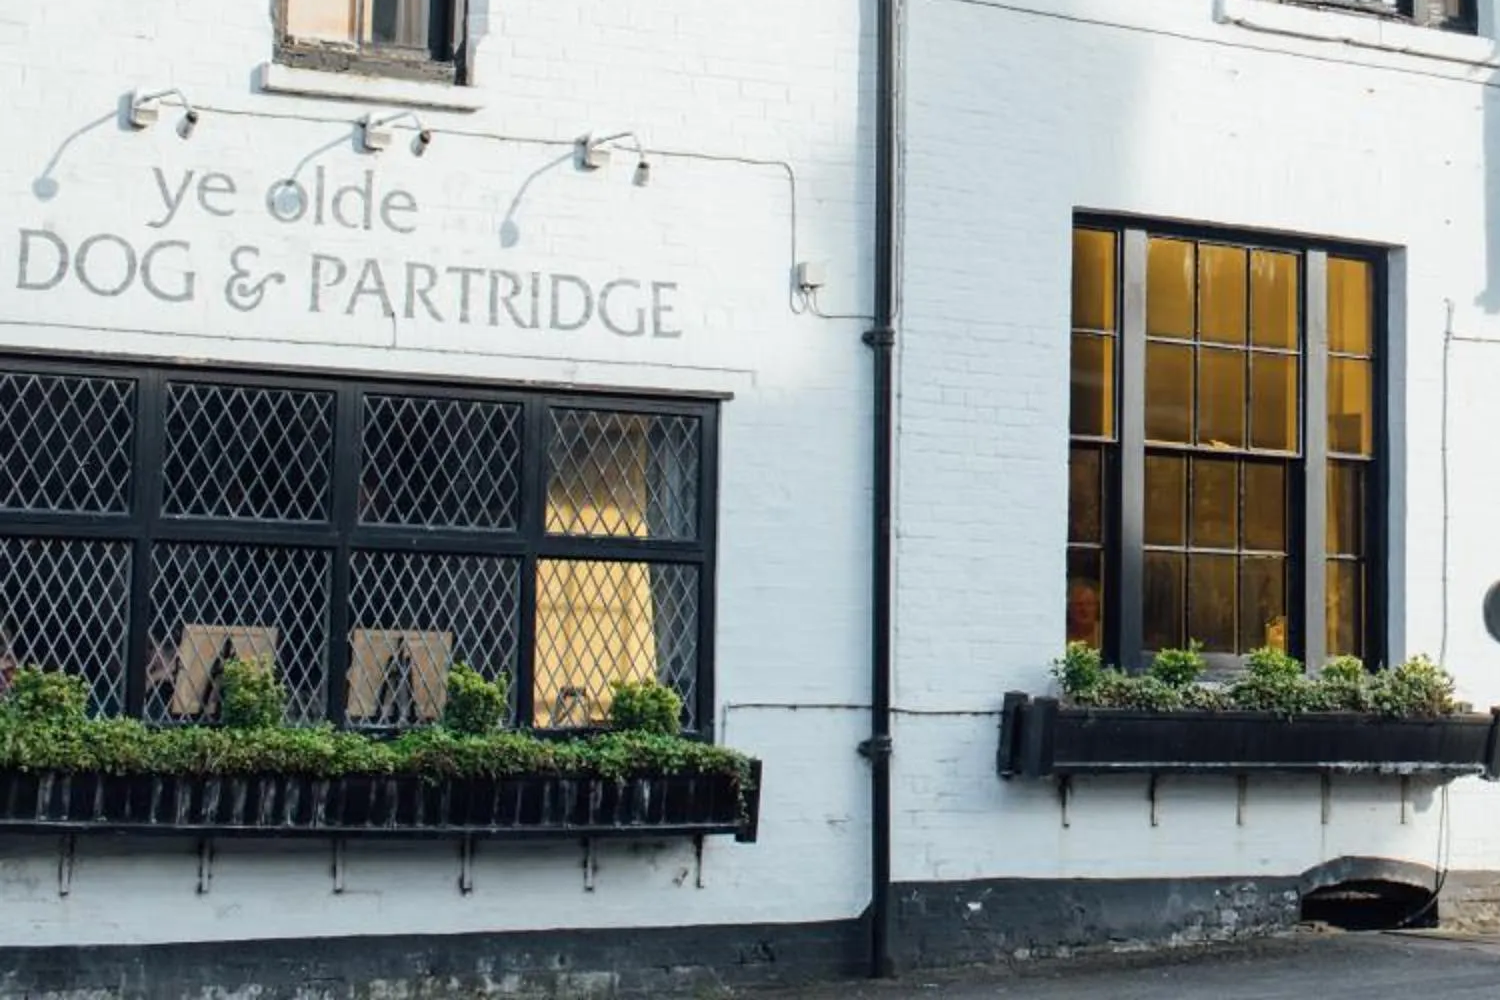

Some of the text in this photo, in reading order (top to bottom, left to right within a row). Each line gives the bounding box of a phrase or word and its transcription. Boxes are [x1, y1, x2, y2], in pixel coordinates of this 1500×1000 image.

[147, 165, 419, 233] ye olde
[15, 228, 683, 339] DOG & PARTRIDGE
